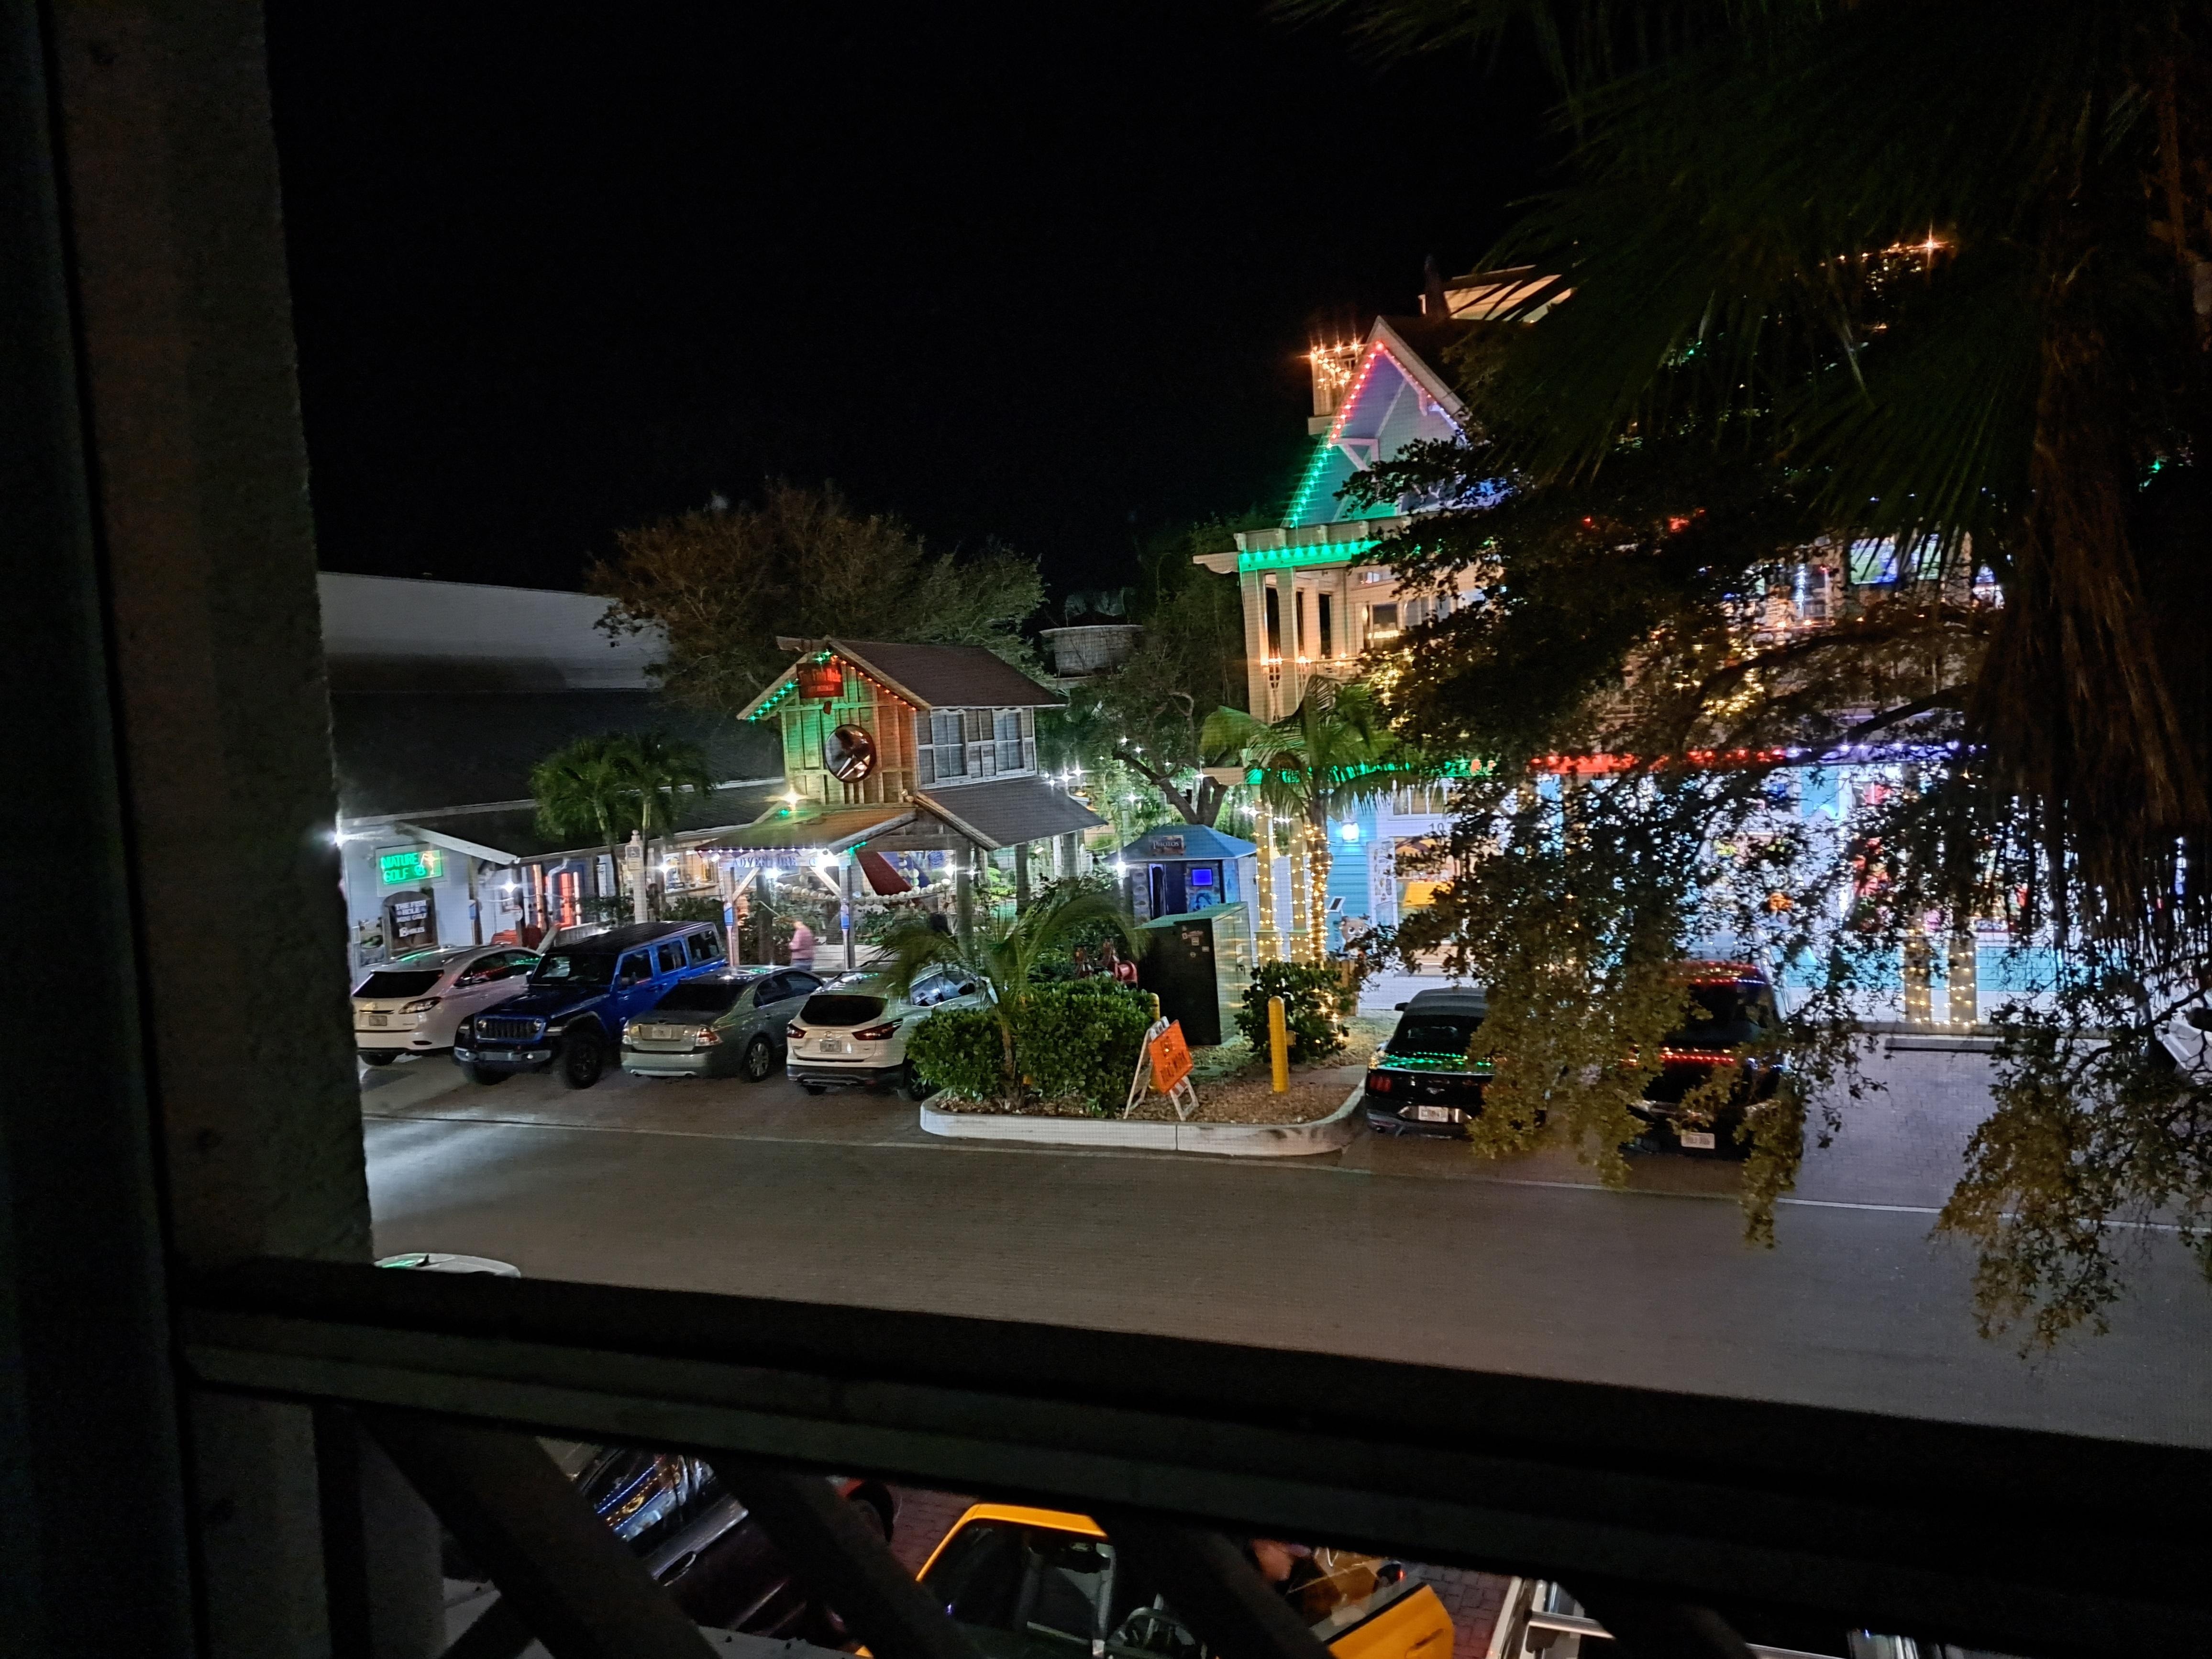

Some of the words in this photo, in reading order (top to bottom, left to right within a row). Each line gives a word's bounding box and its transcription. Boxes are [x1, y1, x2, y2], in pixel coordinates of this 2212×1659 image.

[1152, 841, 1179, 850] PHOTOS
[732, 855, 797, 867] ADVENTURE
[384, 867, 410, 882] GOLF
